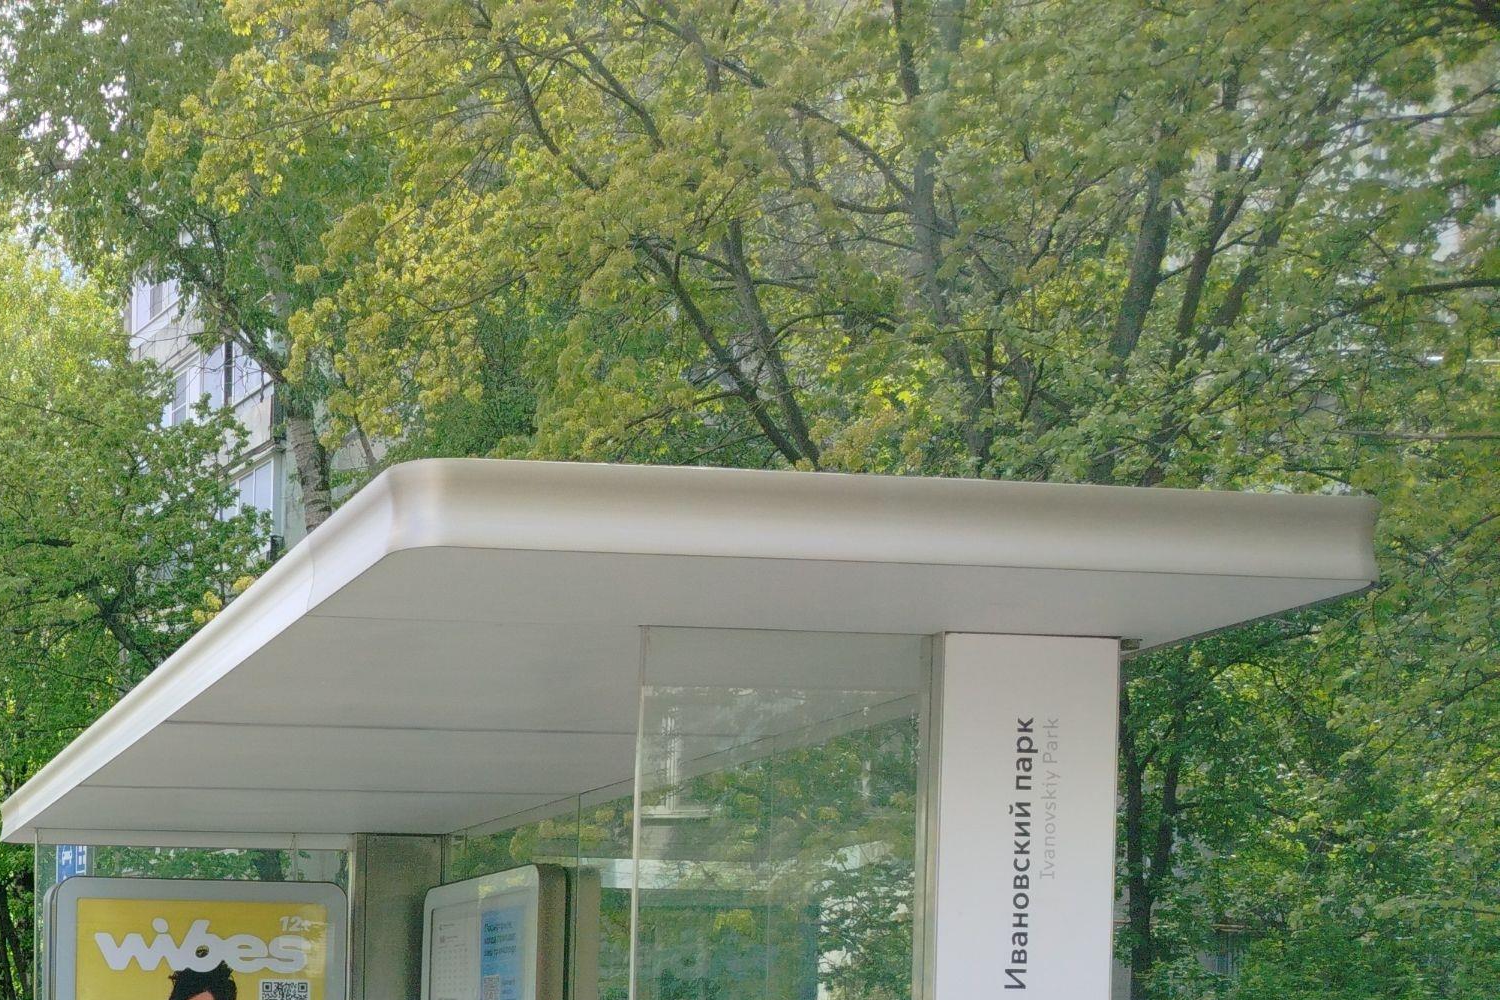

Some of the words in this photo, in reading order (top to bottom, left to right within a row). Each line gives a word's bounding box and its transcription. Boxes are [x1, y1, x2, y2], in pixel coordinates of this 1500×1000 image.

[1014, 716, 1039, 791] парк
[1042, 717, 1060, 764] Park
[1039, 769, 1061, 880] Ivanovskiy
[1004, 801, 1032, 990] Ивановский
[94, 917, 311, 974] wibes
